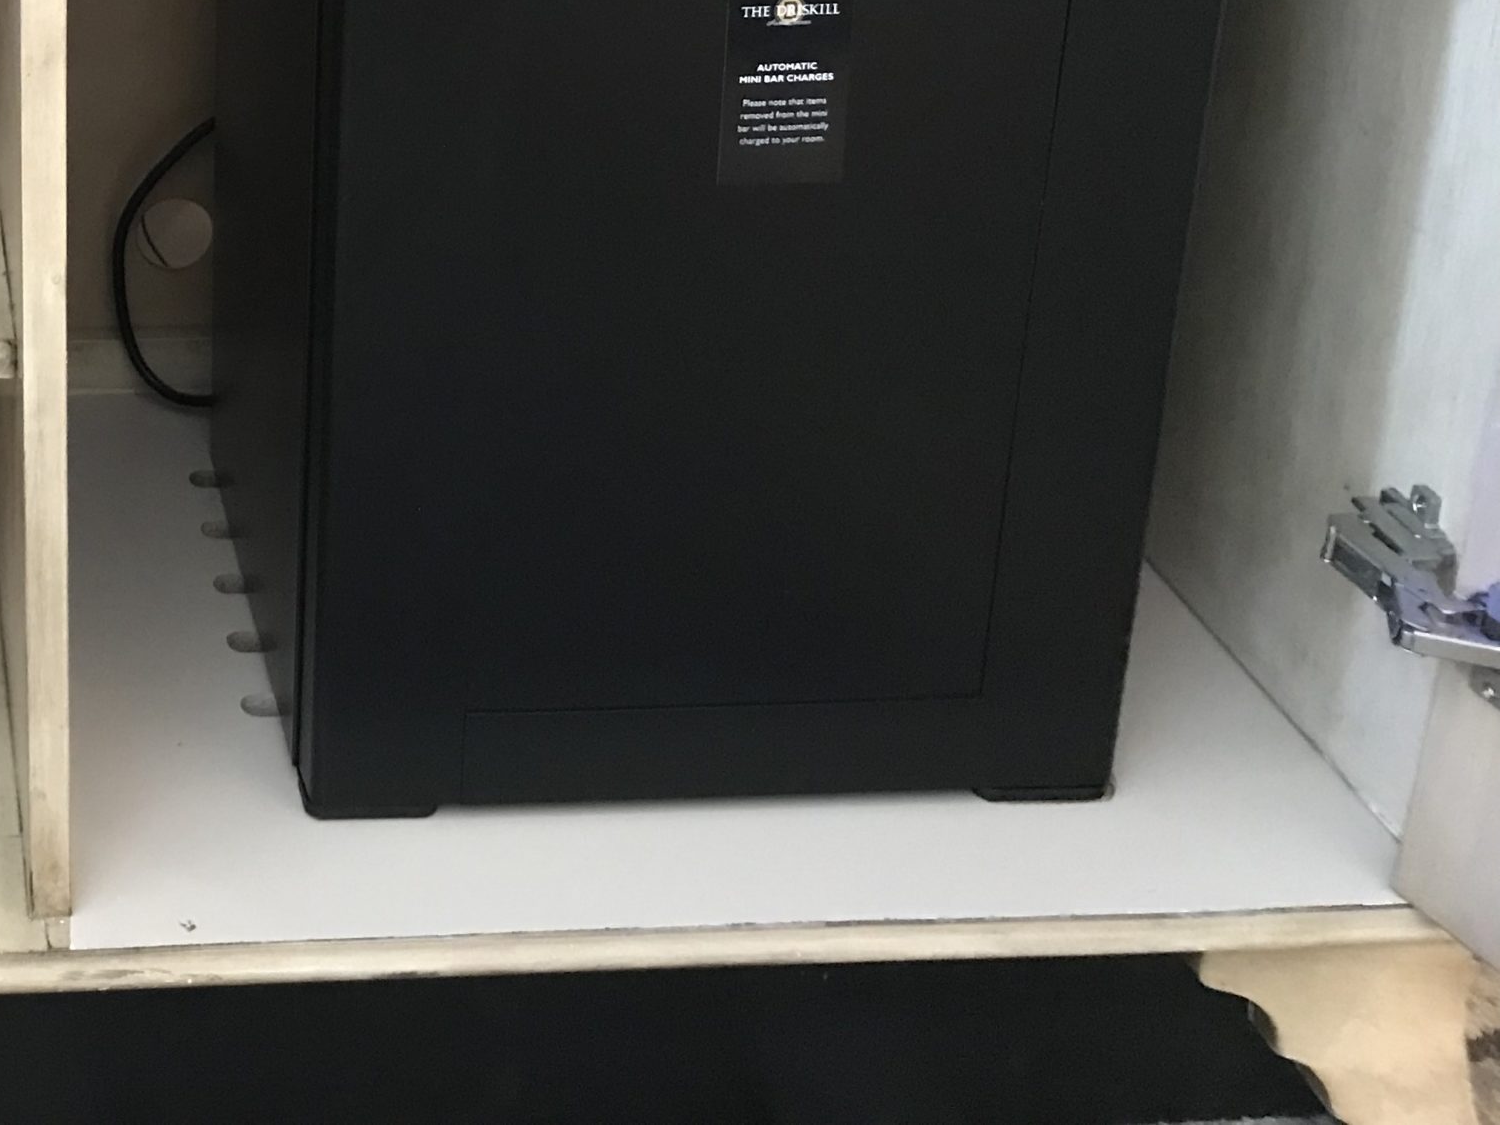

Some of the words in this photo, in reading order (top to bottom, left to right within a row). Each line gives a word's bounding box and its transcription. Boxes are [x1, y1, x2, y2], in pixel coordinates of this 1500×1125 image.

[741, 5, 771, 18] THE
[776, 3, 841, 16] DRISKILL
[756, 61, 819, 72] AUTOMATIC
[739, 75, 762, 84] MINI
[764, 74, 785, 83] BAR
[786, 72, 835, 82] CHARGES
[742, 98, 767, 107] Please
[740, 111, 775, 120] removed
[775, 110, 795, 118] from
[796, 110, 810, 118] the
[737, 125, 750, 133] bar
[752, 124, 766, 132] will
[767, 124, 778, 132] be
[779, 121, 830, 131] automatically
[739, 137, 770, 146] charged
[781, 136, 801, 145] your
